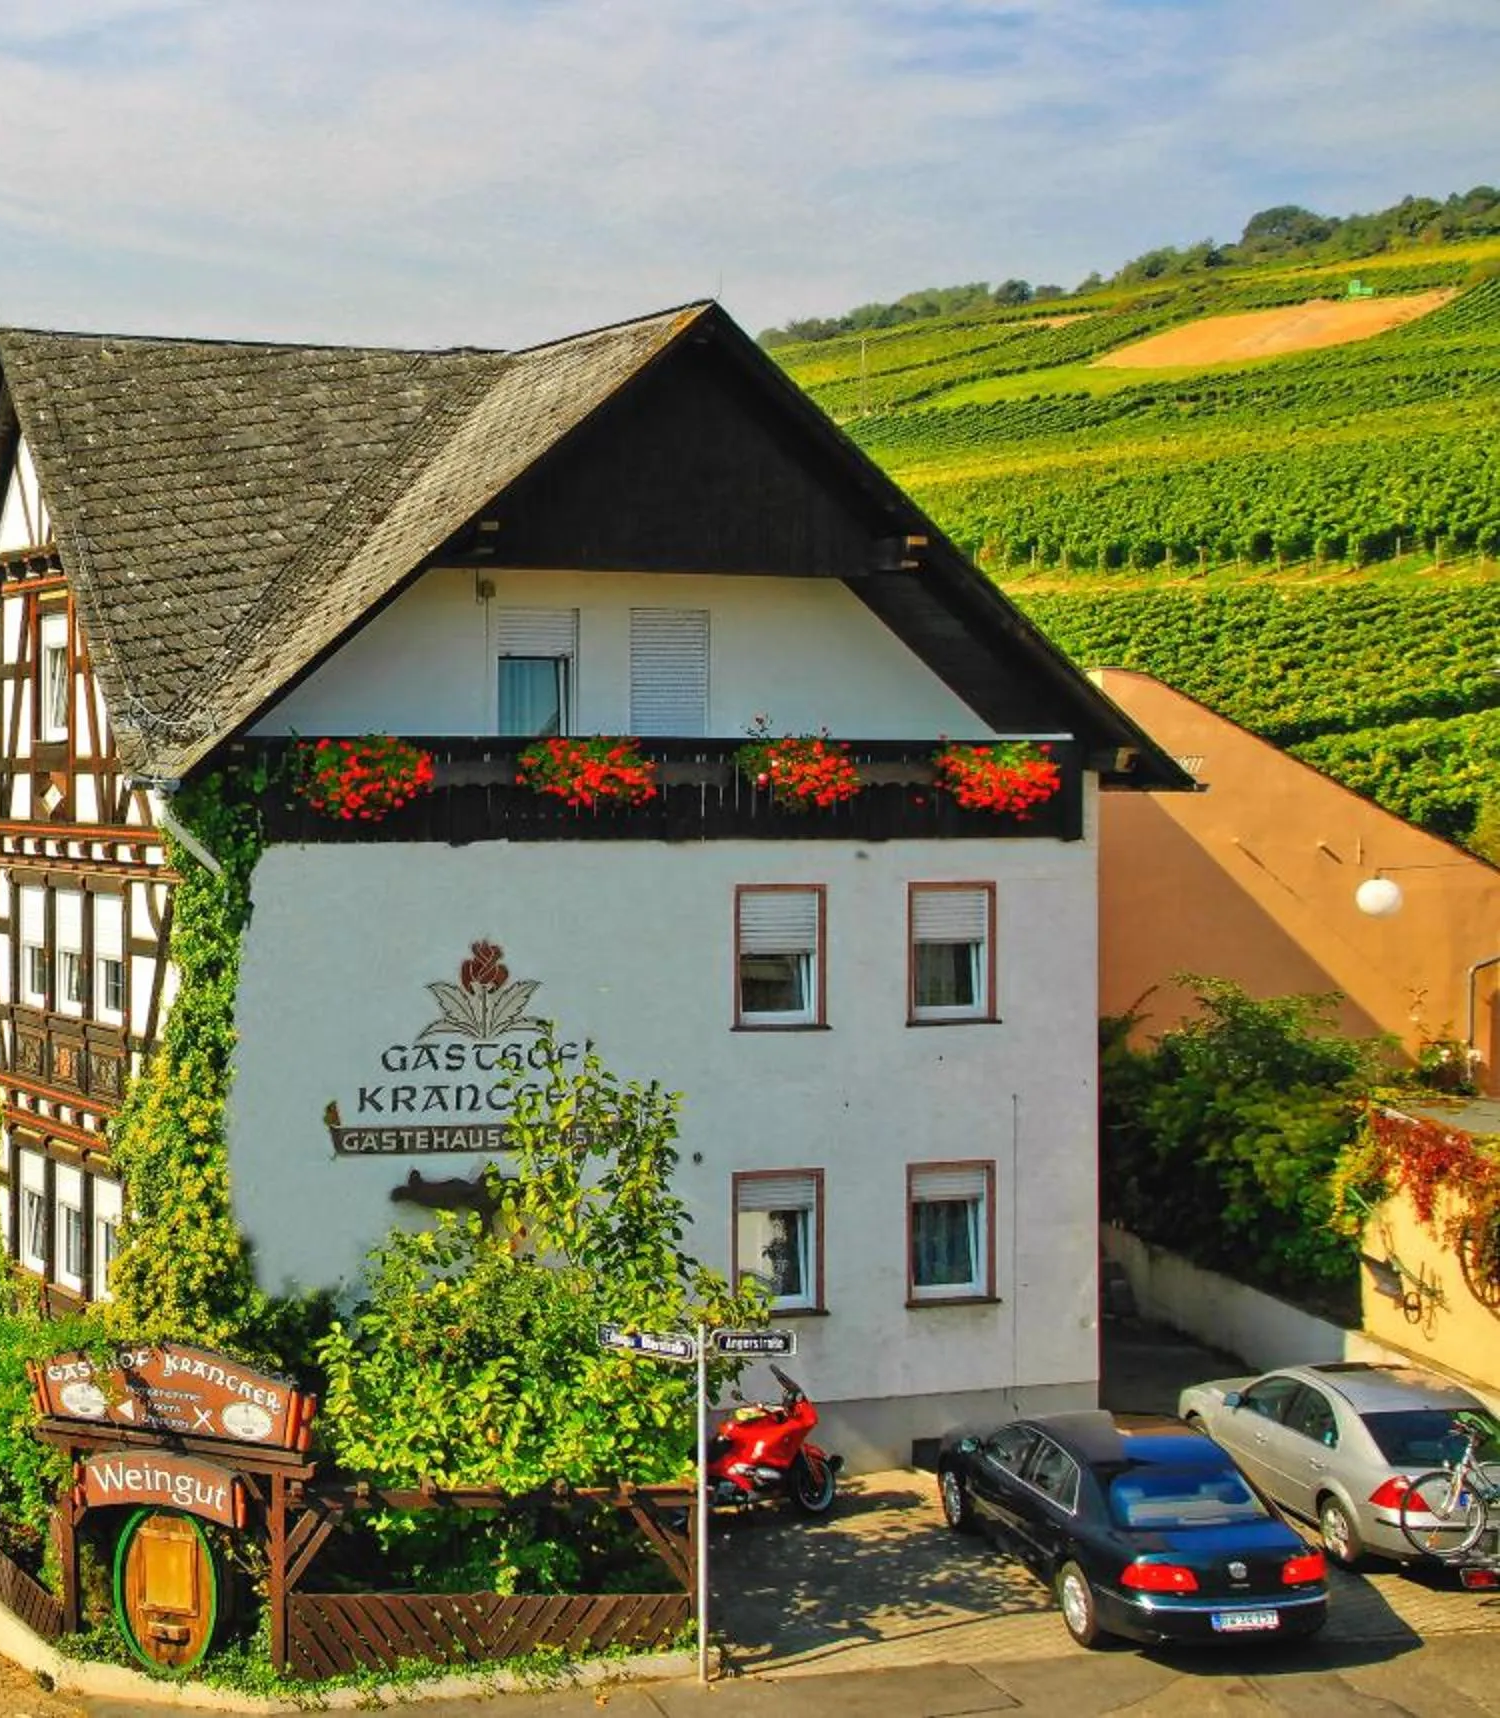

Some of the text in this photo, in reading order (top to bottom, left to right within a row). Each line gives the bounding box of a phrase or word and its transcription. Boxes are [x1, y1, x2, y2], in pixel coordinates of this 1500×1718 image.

[47, 1350, 282, 1415] GASOF KRANCHER
[91, 1460, 228, 1512] Weingut
